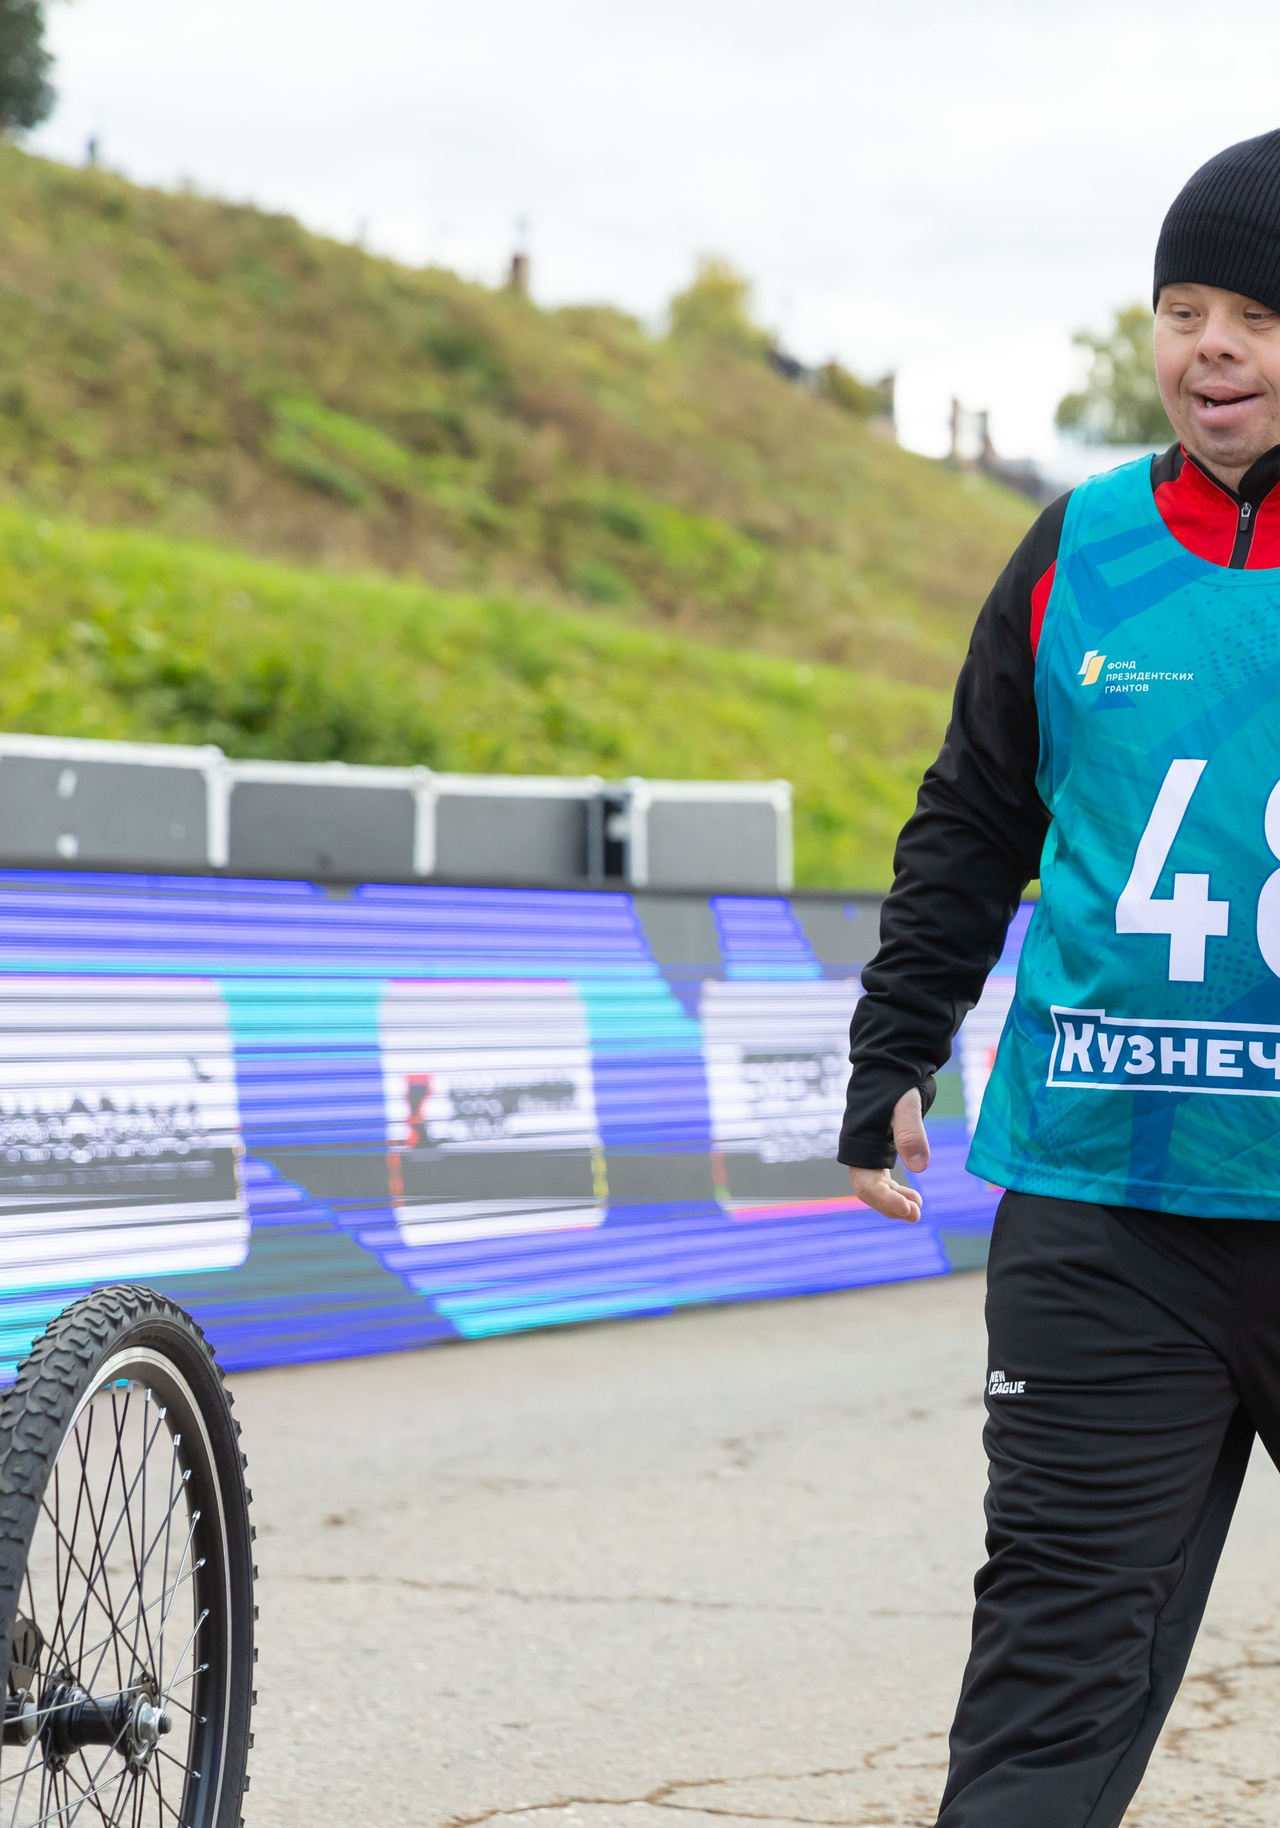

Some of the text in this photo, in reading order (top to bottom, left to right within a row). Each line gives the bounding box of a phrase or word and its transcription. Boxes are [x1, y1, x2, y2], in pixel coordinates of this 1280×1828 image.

[1107, 661, 1136, 670] ФОНД
[1105, 672, 1194, 682] ПРЕЗИДЕНТСКИХ
[1104, 684, 1149, 694] ГРАНТОВ
[990, 1370, 1006, 1383] NEW
